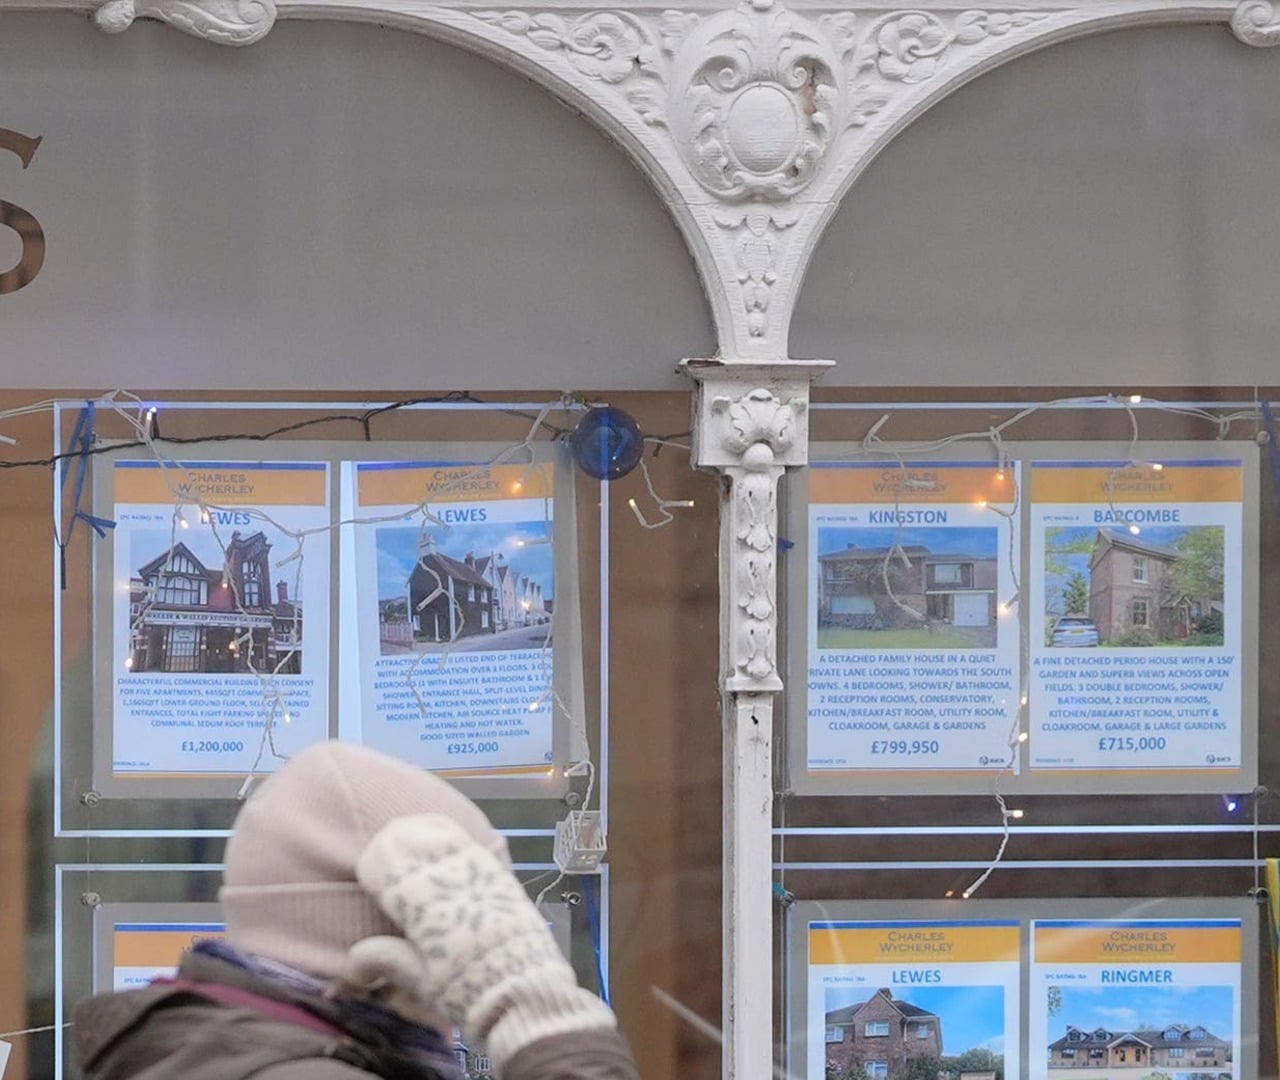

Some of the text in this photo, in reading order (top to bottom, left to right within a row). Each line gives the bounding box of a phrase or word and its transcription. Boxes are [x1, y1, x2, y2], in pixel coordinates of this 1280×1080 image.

[202, 511, 250, 525] LEWES
[438, 508, 486, 523] LEWES
[869, 510, 947, 523] KINGSTON
[182, 741, 244, 753] £1,200,000
[448, 742, 498, 754] £925,000
[872, 740, 939, 755] £799,950
[1098, 737, 1166, 752] £715,000
[888, 932, 945, 941] CHARLES
[880, 944, 953, 953] WYCHERLEY
[892, 970, 941, 983] LEWES
[1101, 970, 1172, 983] RINGMER
